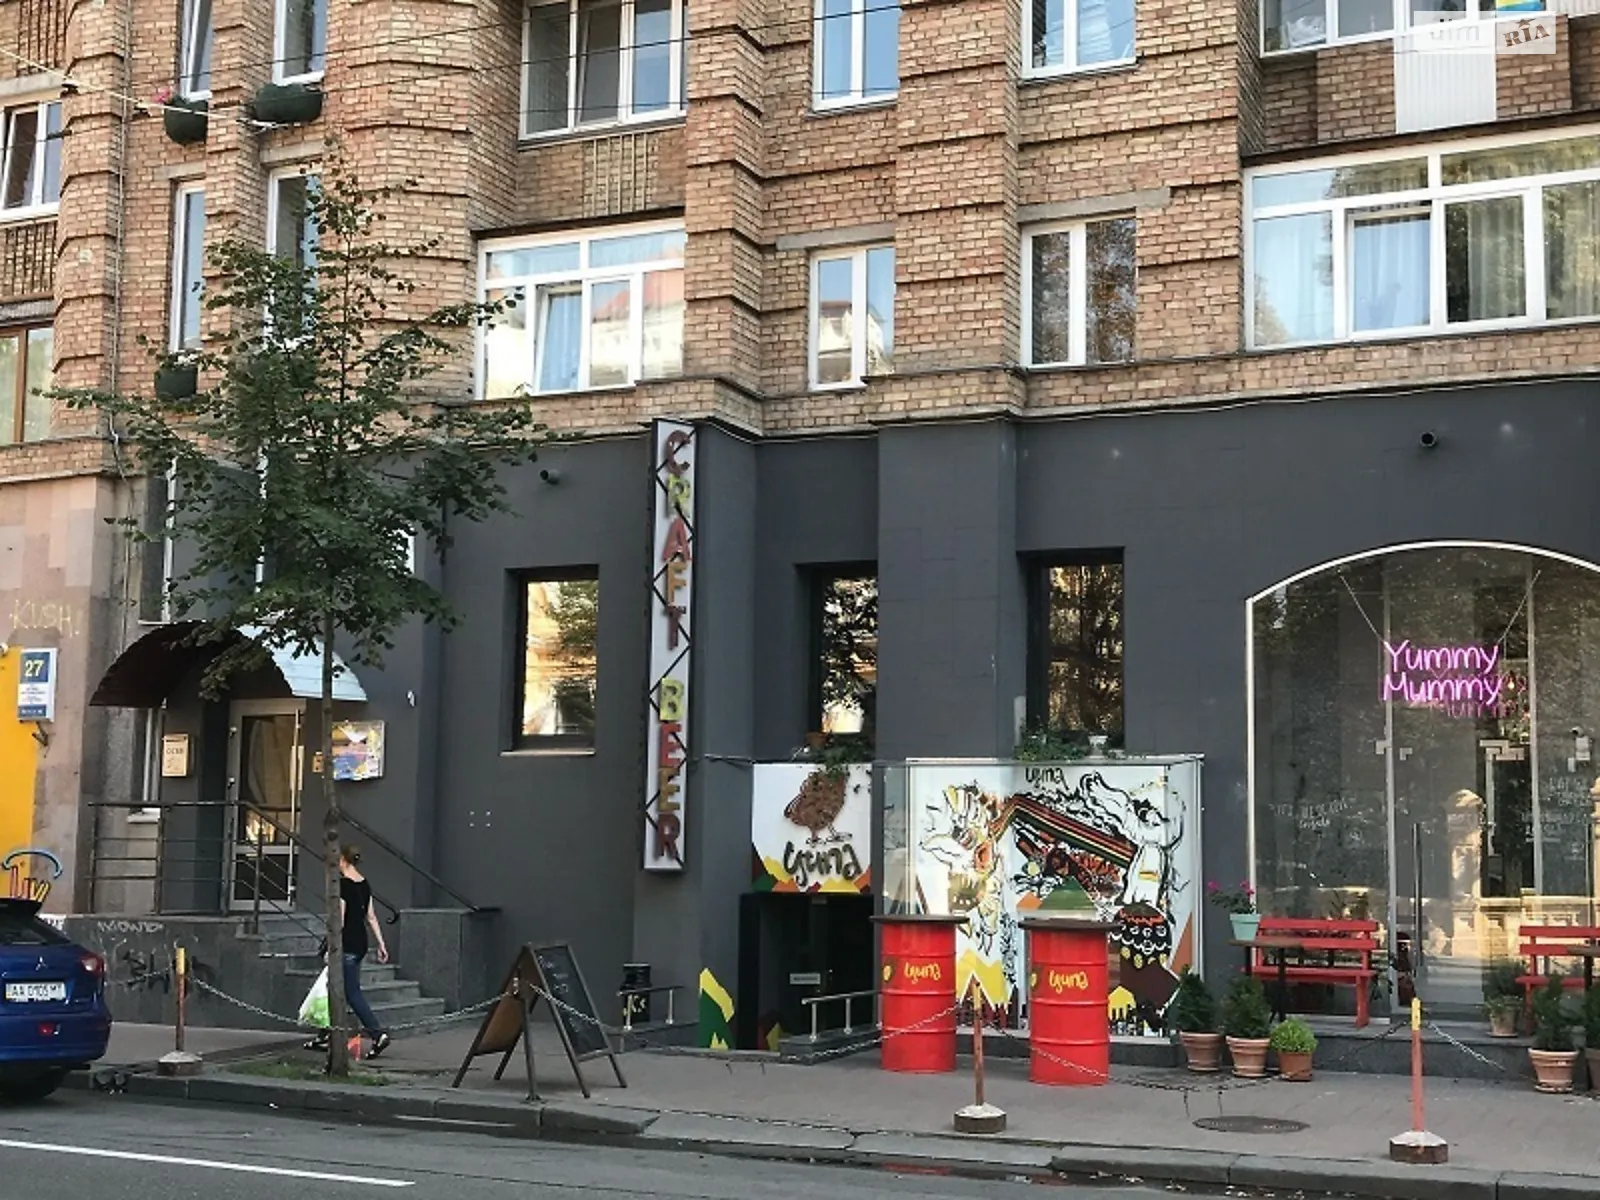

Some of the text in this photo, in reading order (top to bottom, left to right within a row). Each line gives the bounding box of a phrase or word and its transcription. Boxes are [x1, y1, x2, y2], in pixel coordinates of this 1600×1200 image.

[655, 428, 693, 860] CRAFT BEER
[1383, 638, 1499, 675] Yummy
[24, 659, 45, 678] 27
[1383, 670, 1502, 706] Mummy
